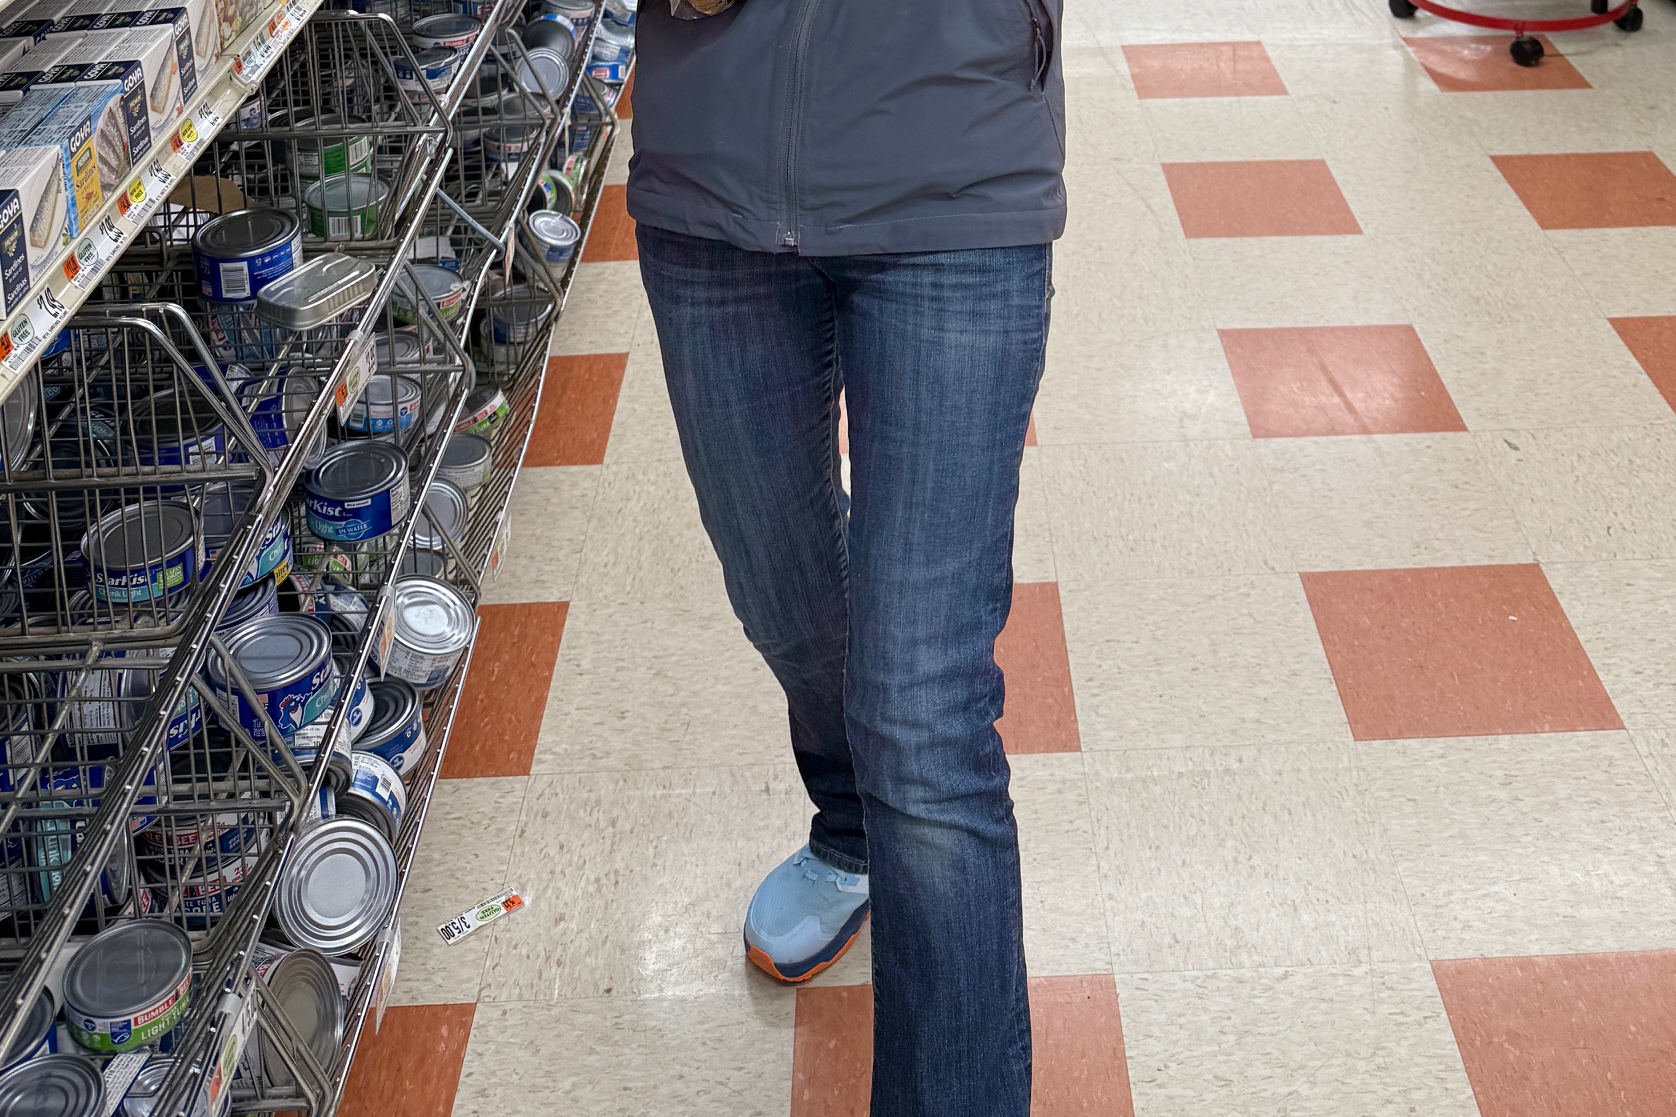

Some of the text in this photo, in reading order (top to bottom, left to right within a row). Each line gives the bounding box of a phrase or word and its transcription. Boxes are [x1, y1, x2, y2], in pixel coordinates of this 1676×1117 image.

[174, 13, 189, 35] GOYA
[123, 68, 143, 92] GOYA
[130, 114, 147, 135] Sardines
[70, 120, 91, 153] GOYA
[79, 242, 93, 260] GLUTEN
[4, 253, 25, 281] Sardines
[12, 318, 28, 339] GLUTEN
[18, 328, 31, 343] FREE
[315, 521, 333, 534] Light
[479, 906, 500, 921] GLUTEN
[440, 916, 471, 941] 3/5.00
[137, 995, 175, 1026] BUMBLE
[141, 1018, 171, 1041] LIGHT
